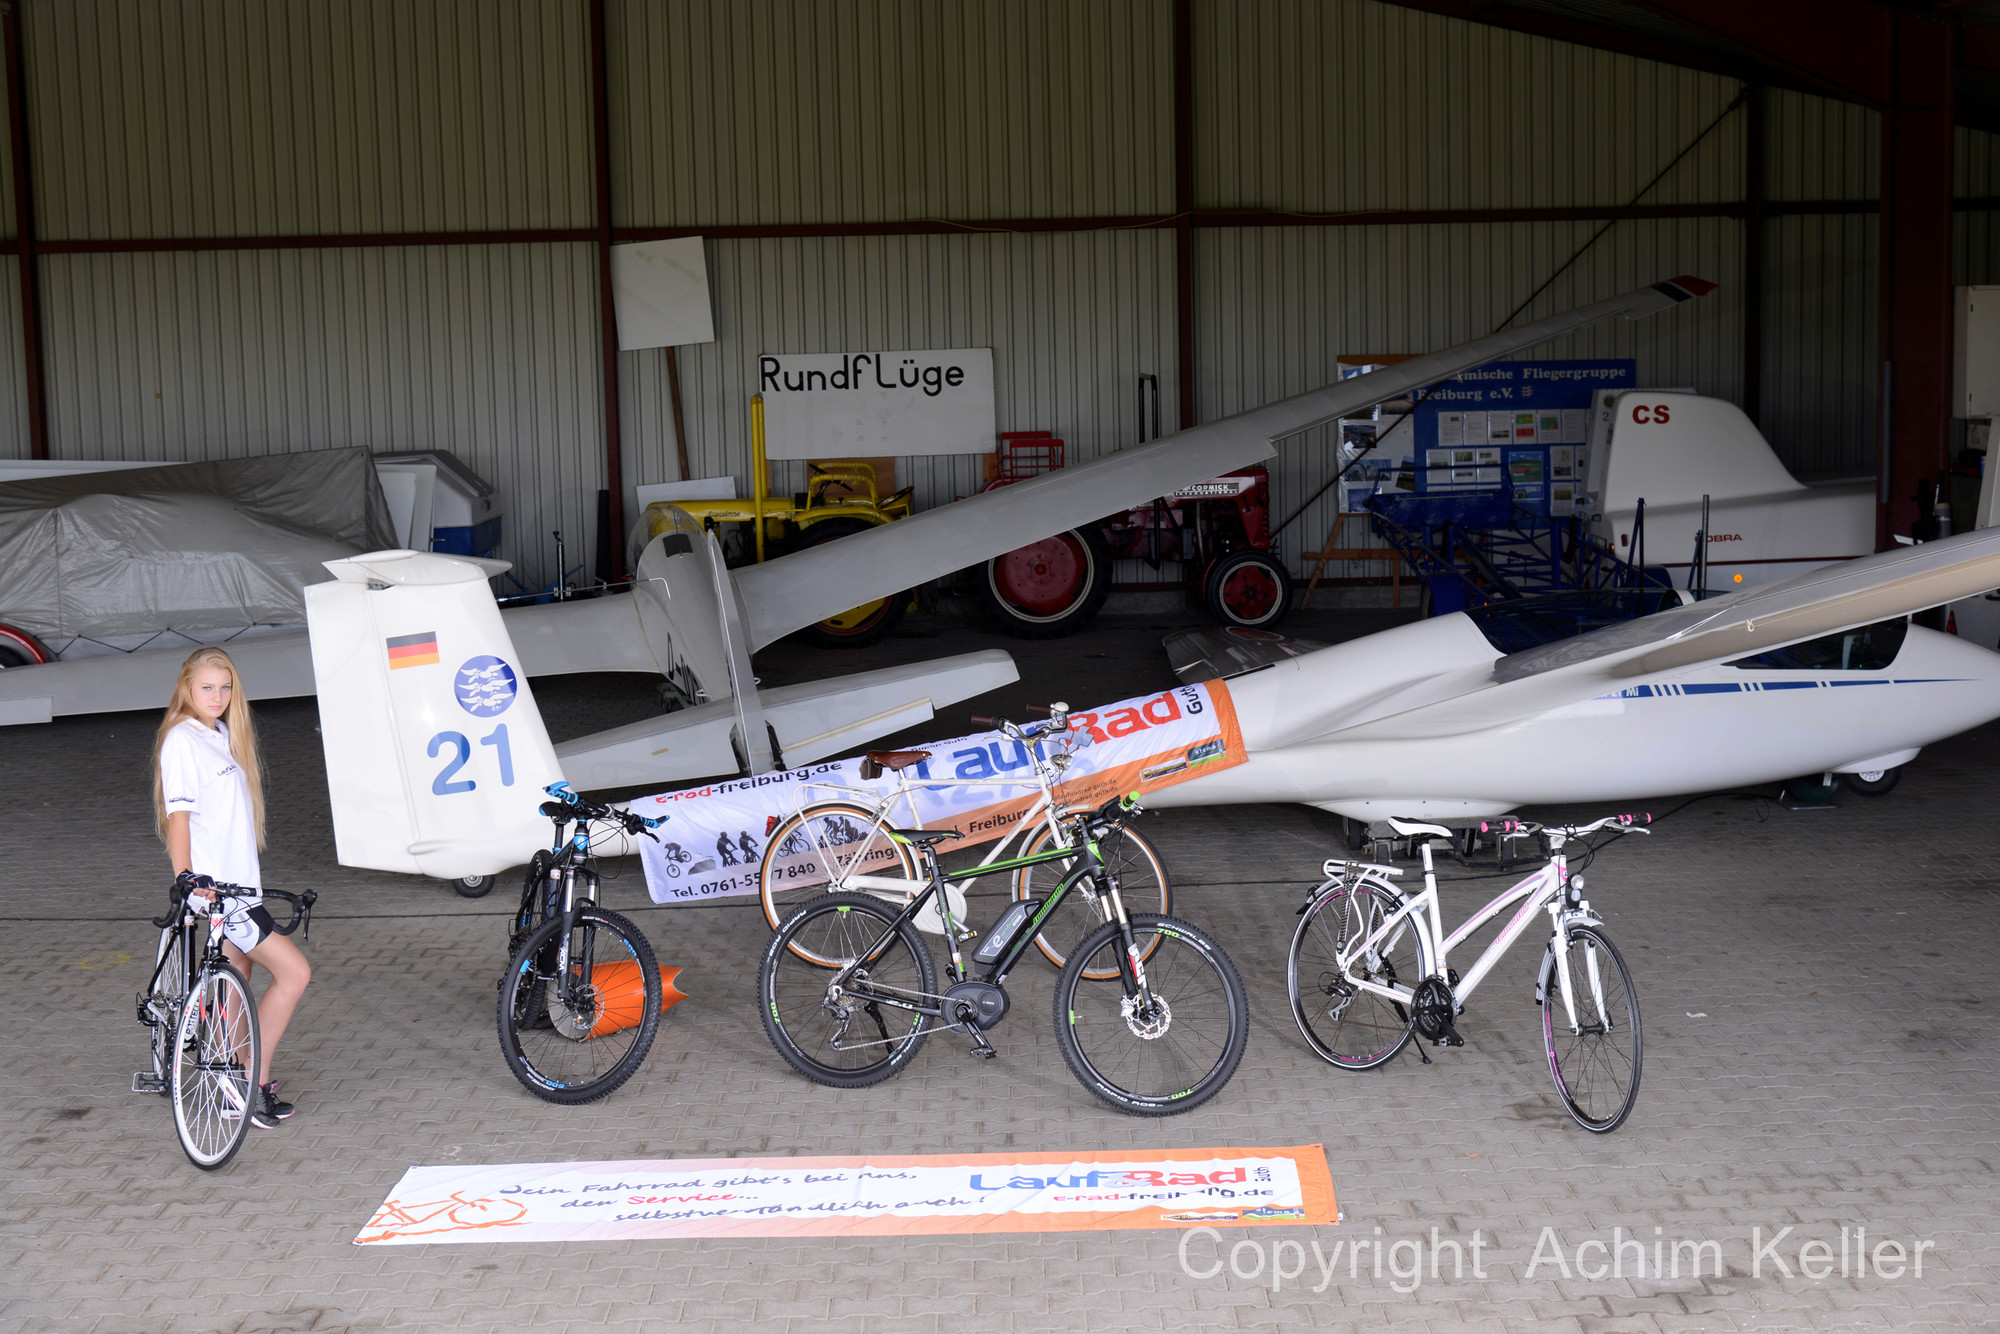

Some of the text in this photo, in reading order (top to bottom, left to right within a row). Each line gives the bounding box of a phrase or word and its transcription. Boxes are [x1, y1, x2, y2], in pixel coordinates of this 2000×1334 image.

[760, 354, 964, 397] Rundflüge
[1523, 366, 1626, 381] Fliegergruppe
[1417, 387, 1513, 403] Freiburg e.V.
[1632, 405, 1670, 424] CS
[427, 723, 514, 796] 21
[671, 863, 816, 899] Tel. 0761-557 840
[582, 1179, 706, 1193] Fahrrad
[804, 1174, 848, 1183] bei
[560, 1199, 618, 1208] den
